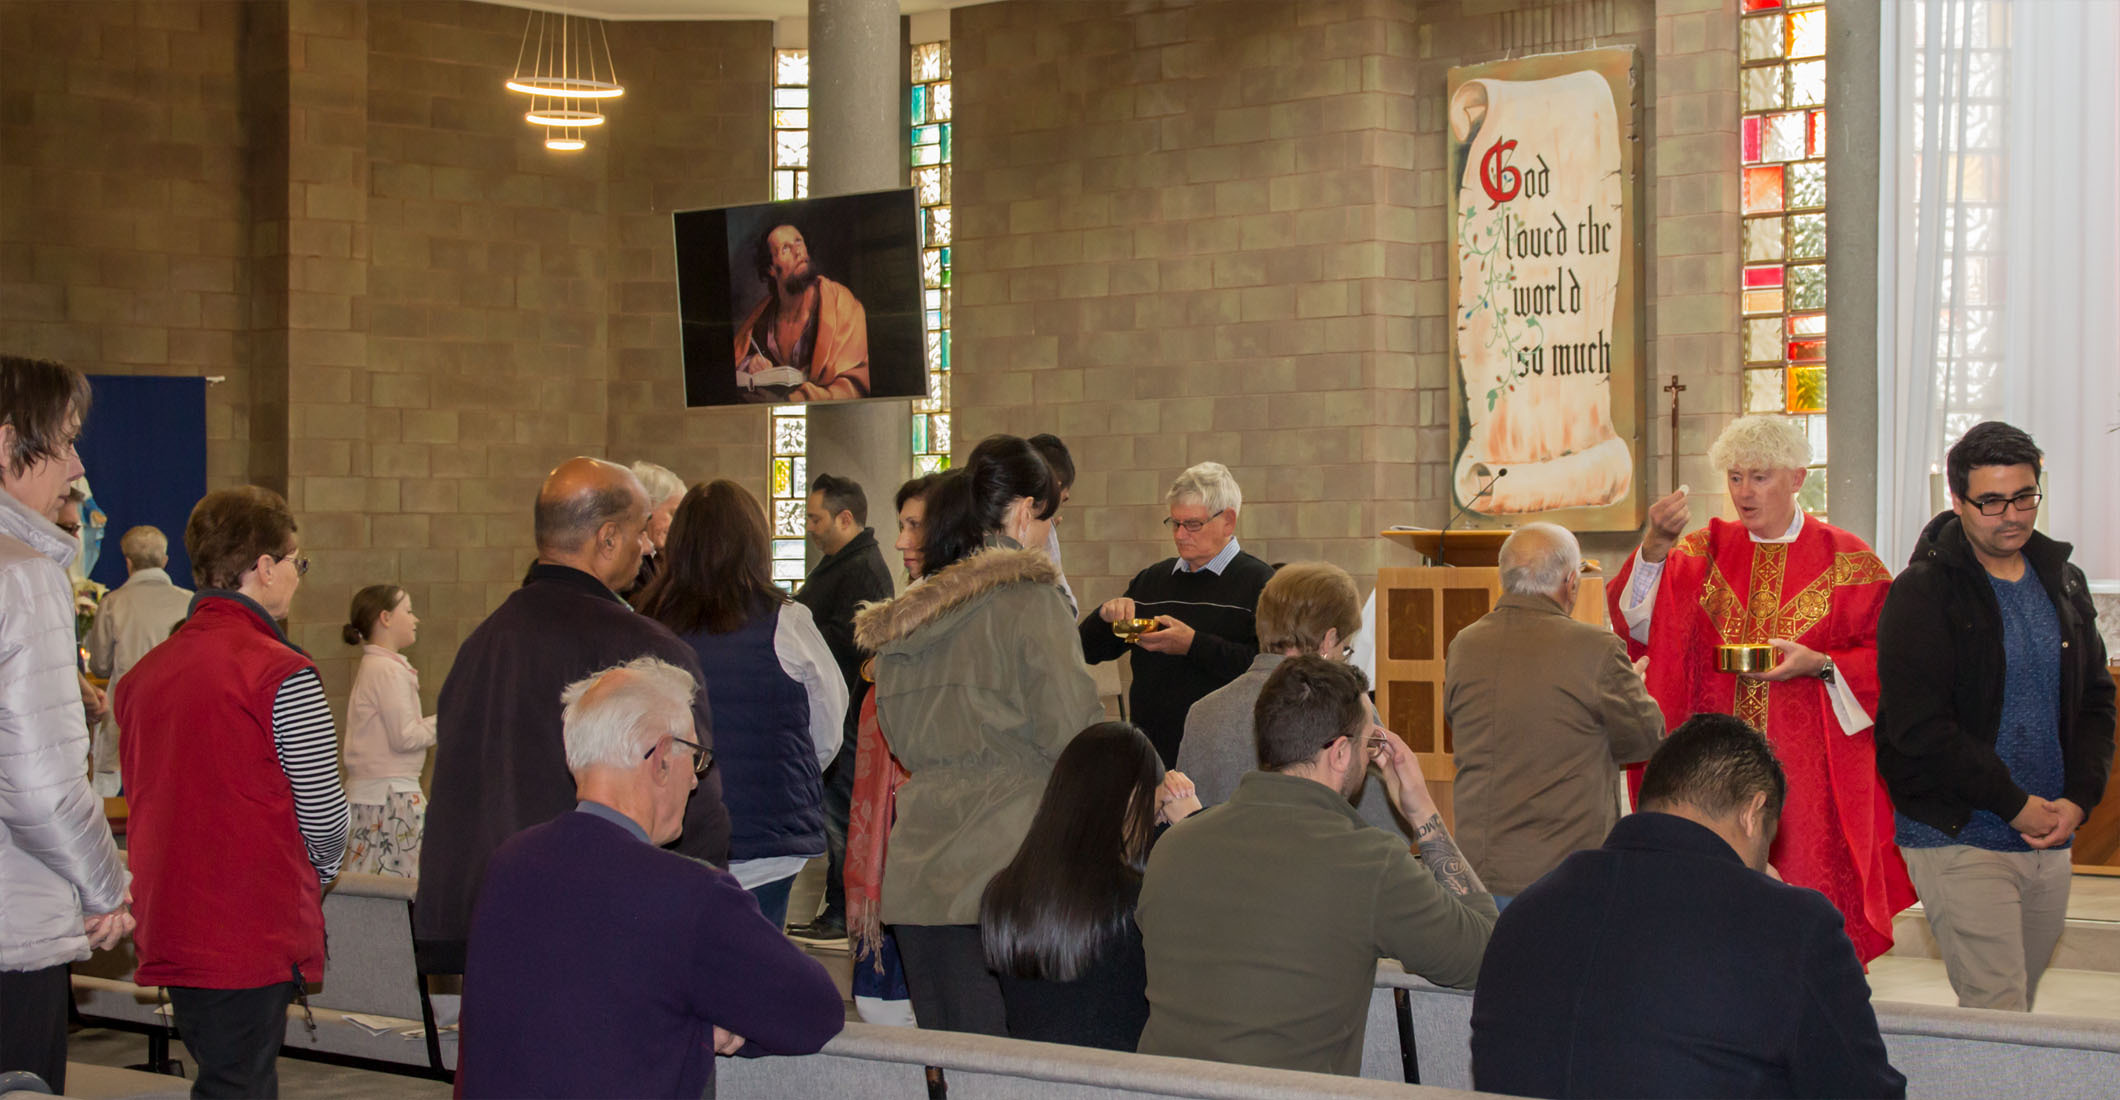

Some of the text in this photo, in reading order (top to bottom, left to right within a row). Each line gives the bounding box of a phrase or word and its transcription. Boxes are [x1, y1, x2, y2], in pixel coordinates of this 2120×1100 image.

[1480, 135, 1550, 210] God
[1505, 204, 1612, 260] loved the
[1513, 266, 1581, 317] world
[1517, 329, 1611, 378] so much
